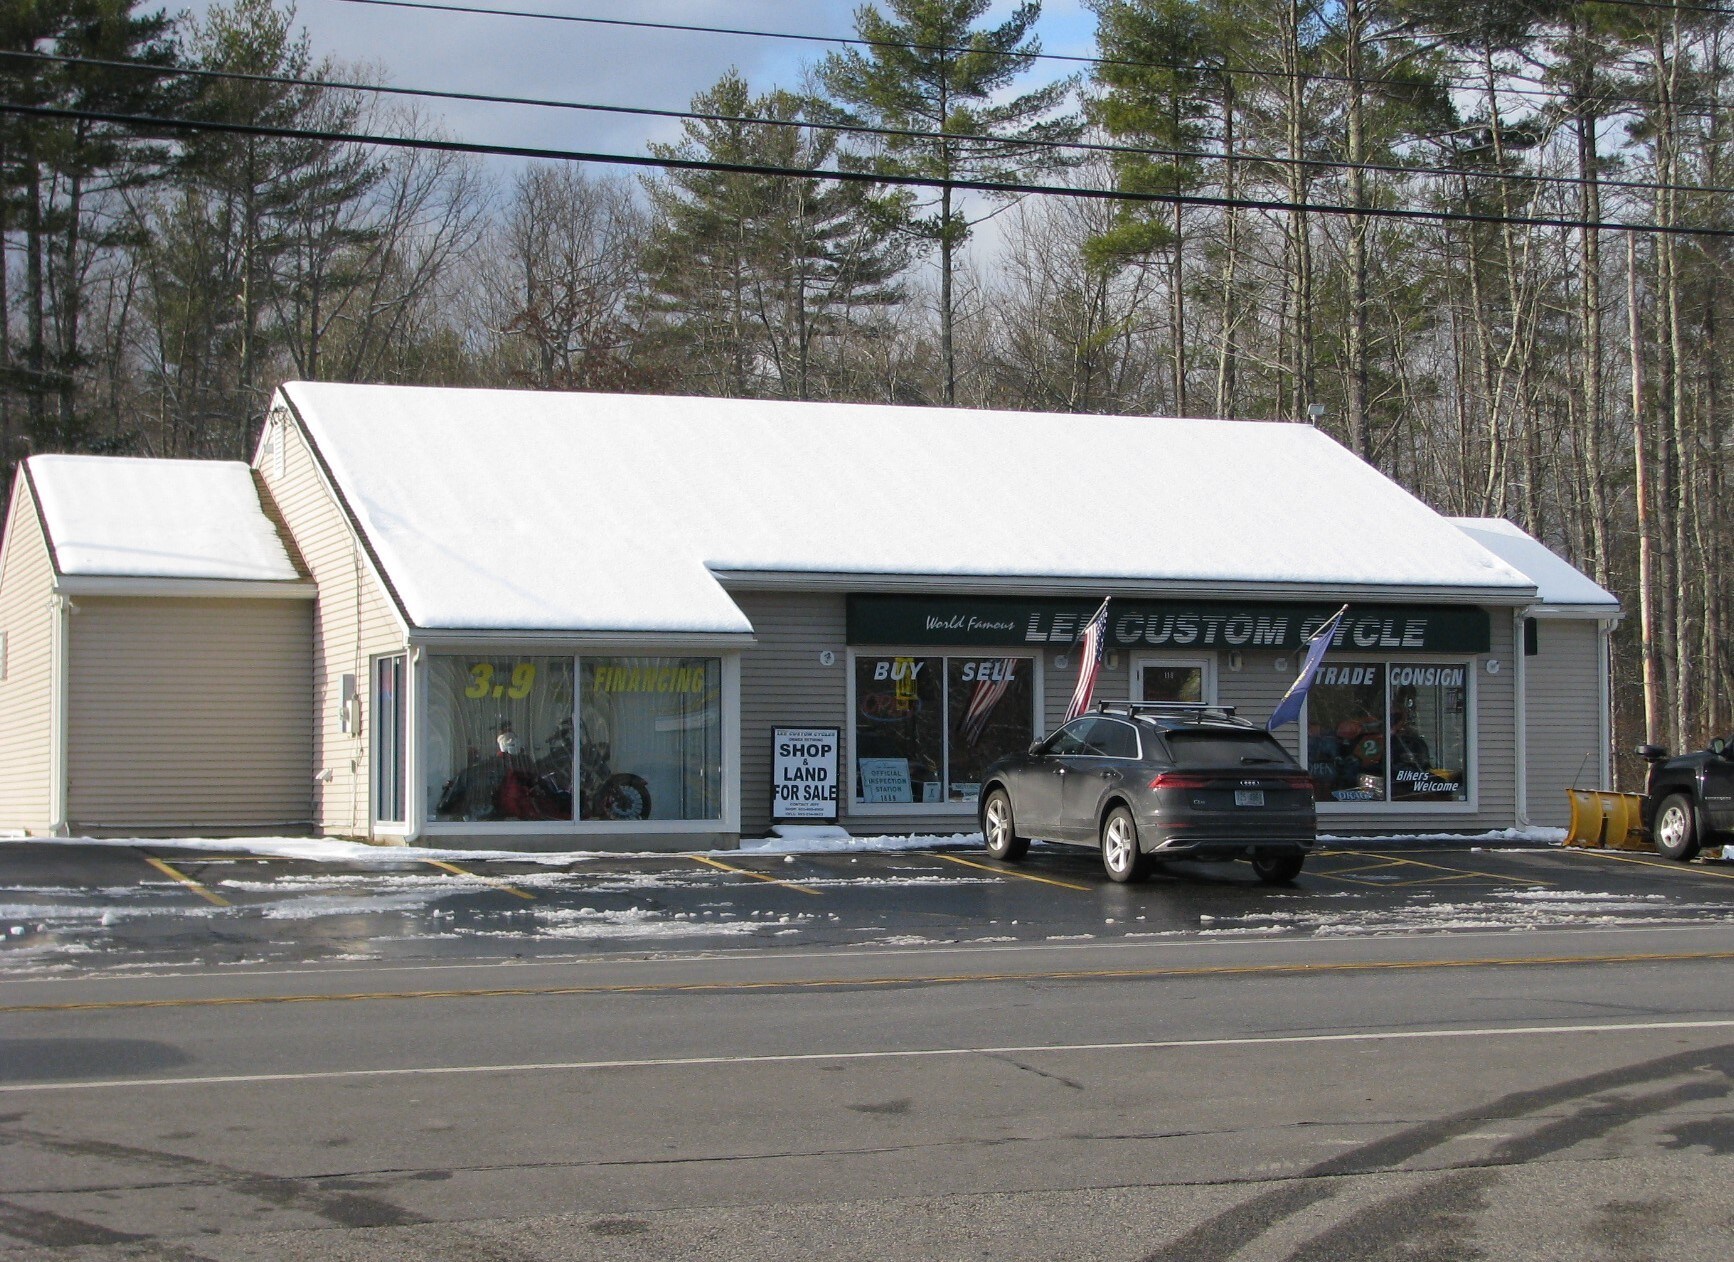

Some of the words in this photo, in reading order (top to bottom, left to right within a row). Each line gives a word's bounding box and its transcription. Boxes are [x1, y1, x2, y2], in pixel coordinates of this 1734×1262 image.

[925, 615, 965, 631] World
[967, 616, 1016, 632] Famous
[1115, 612, 1289, 645] CUSTOM
[1300, 615, 1429, 647] CYCLE
[873, 661, 925, 681] BUY
[961, 662, 1017, 682] SELL
[1315, 667, 1376, 686] TRADE
[1390, 667, 1464, 686] CONSIGN
[465, 663, 537, 698] 3.9
[593, 667, 705, 693] FINANCING
[780, 743, 832, 758] SHOP
[802, 758, 809, 766] &
[783, 767, 828, 782] LAND
[1395, 770, 1430, 781] Bikers
[774, 784, 800, 801] FOR
[803, 784, 837, 801] SALE
[1413, 781, 1459, 792] Welcome
